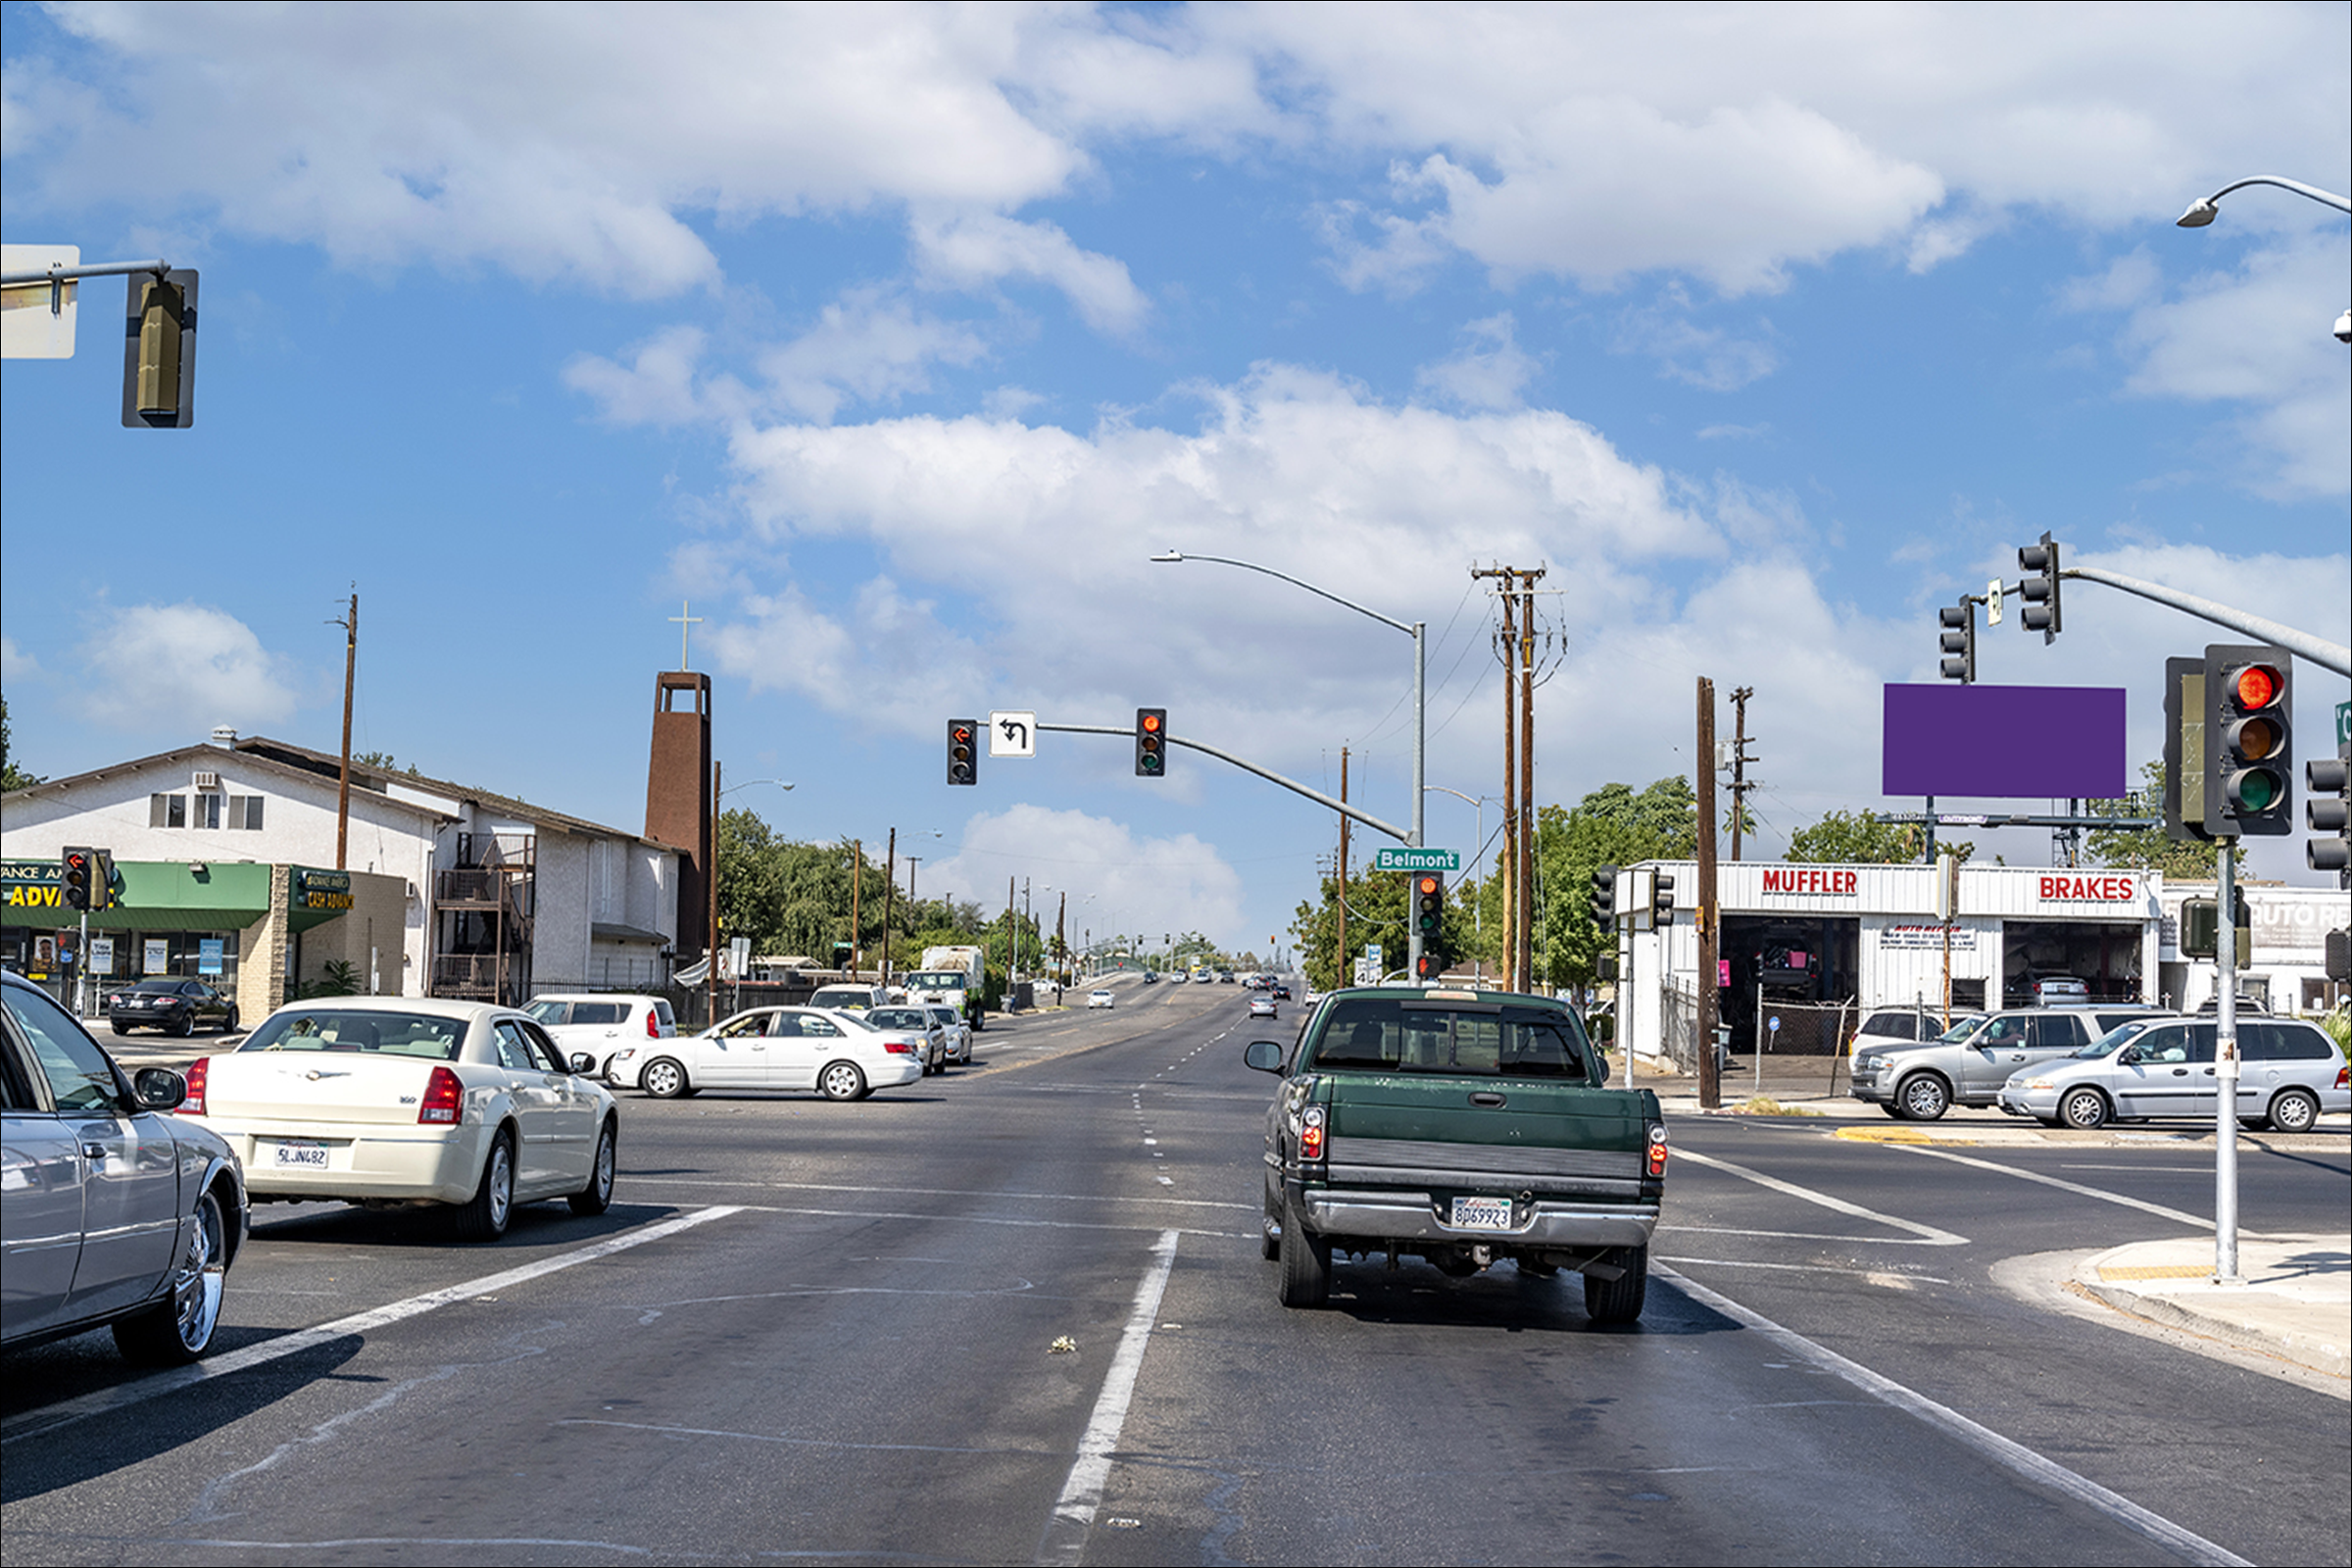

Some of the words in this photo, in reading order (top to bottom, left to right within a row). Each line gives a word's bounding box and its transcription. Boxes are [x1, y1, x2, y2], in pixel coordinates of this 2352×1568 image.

[1381, 851, 1454, 867] Belmont
[1763, 870, 1857, 893] MUFFLER
[2040, 877, 2133, 900] BRAKES
